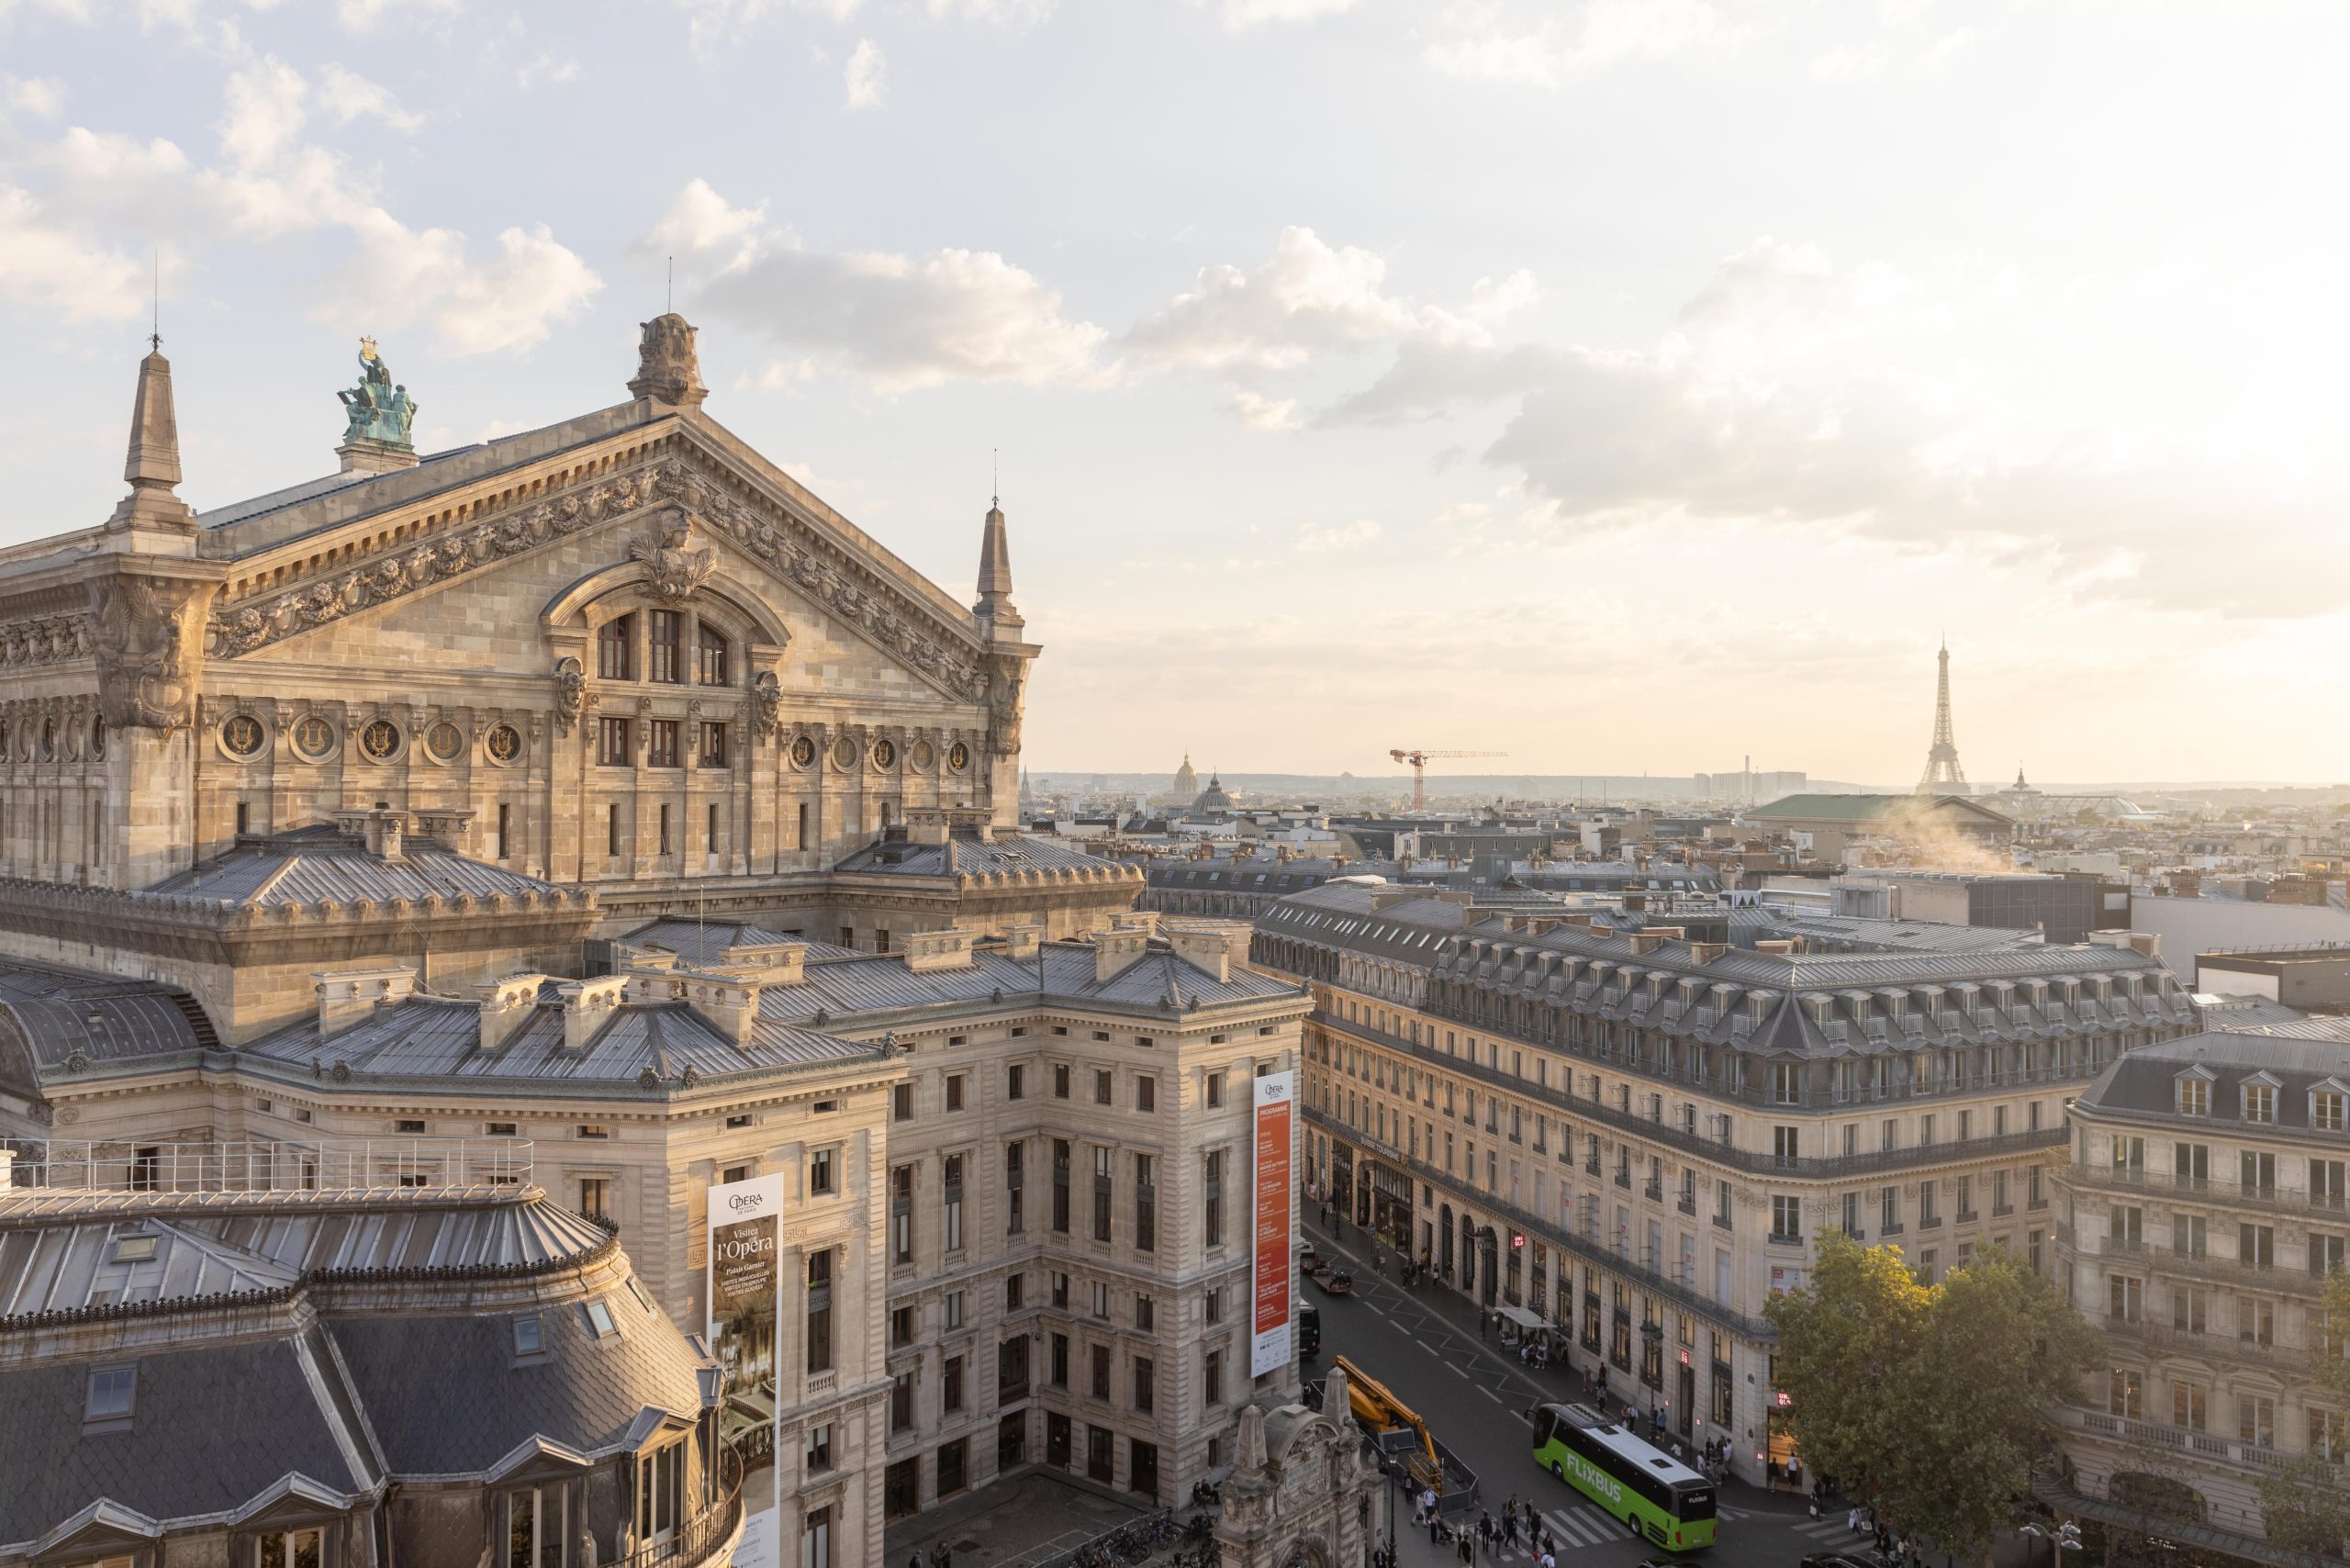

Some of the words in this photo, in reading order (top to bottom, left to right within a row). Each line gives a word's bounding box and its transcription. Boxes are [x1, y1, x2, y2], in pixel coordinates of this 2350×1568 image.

[1259, 1104, 1288, 1117] PROGRAMME
[1360, 1137, 1376, 1150] SUISSE
[1376, 1144, 1400, 1162] TOURISME
[729, 1193, 763, 1210] OPÉRA
[733, 1227, 759, 1238] Visitez
[717, 1237, 773, 1260] l'Opéra
[726, 1266, 744, 1275] Palais
[744, 1260, 766, 1271] Garnier
[721, 1278, 737, 1286] VISITES
[724, 1283, 741, 1292] VISITES
[748, 1277, 767, 1286] GROUPE
[726, 1288, 744, 1297] VISITES
